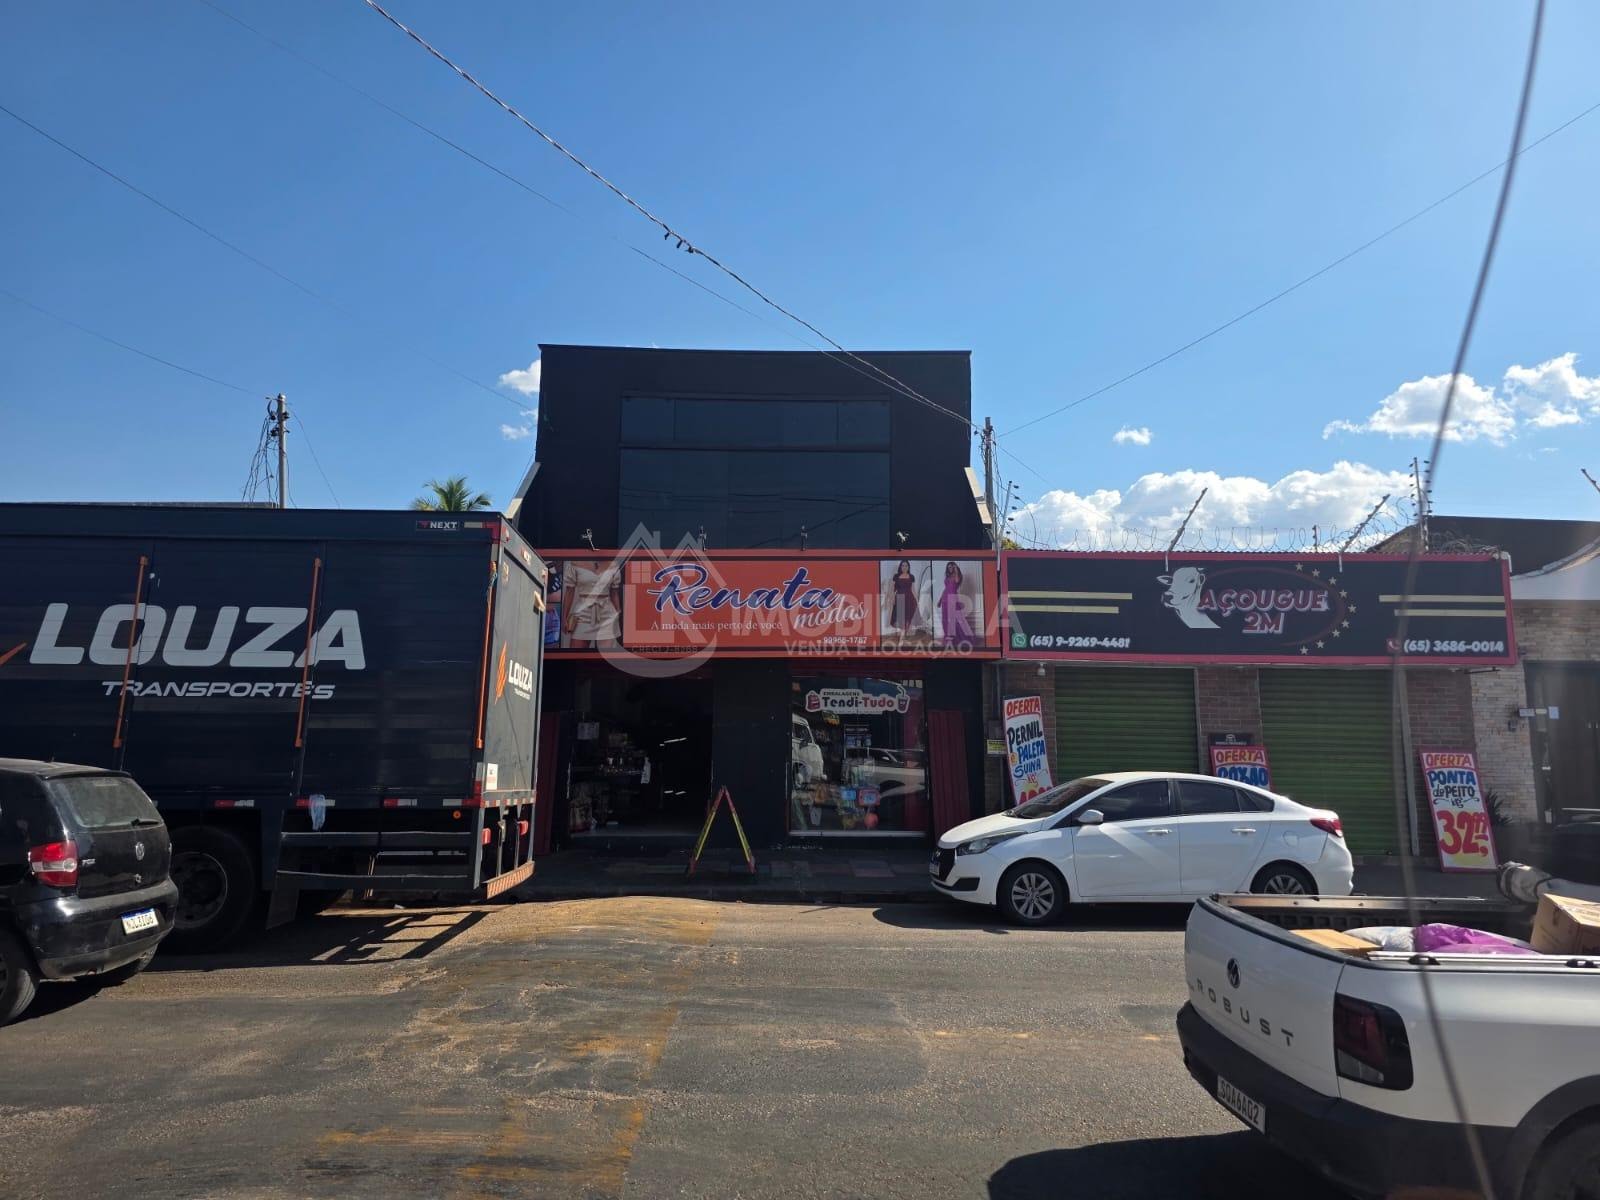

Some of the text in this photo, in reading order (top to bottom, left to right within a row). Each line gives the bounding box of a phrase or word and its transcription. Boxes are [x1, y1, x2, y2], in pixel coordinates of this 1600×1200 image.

[647, 562, 839, 615] Renata
[793, 595, 869, 630] modas
[1196, 588, 1330, 617] AÇOUGUE
[651, 620, 659, 631] A
[662, 619, 688, 630] moda
[692, 620, 712, 631] mais
[717, 620, 745, 633] perto
[746, 619, 758, 630] de
[1242, 611, 1286, 634] 2M
[29, 602, 366, 670] LOUZA
[1030, 634, 1054, 648] (65)
[1403, 639, 1504, 653] (65) 3686-0014
[508, 659, 533, 693] LOUZA
[102, 680, 336, 700] TRANSPORTES
[822, 696, 894, 708] Tendi-Tudo
[1006, 697, 1041, 715] OFERTA
[1007, 720, 1042, 753] PERNIL
[1017, 740, 1046, 764] PALETA
[1216, 750, 1265, 763] OFERTA
[1426, 754, 1472, 767] OFERTA
[1427, 770, 1476, 788] PONTA
[1445, 785, 1475, 798] PEITO
[1197, 977, 1294, 1047] ROBUST
